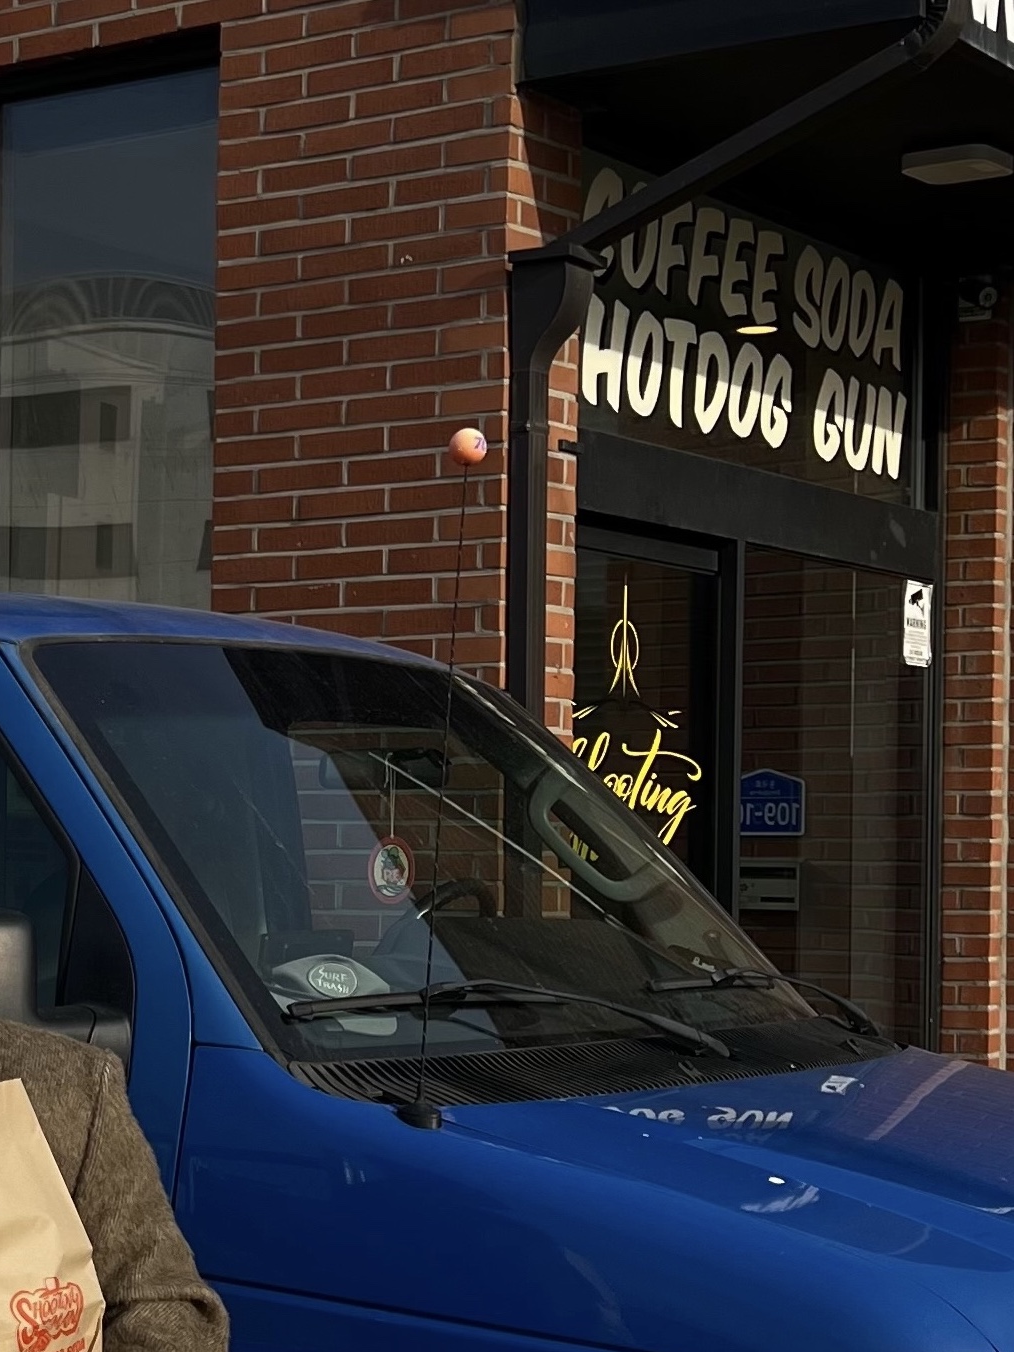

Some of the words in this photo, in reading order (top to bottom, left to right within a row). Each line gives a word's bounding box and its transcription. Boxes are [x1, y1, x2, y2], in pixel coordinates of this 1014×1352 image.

[793, 246, 903, 371] SODA
[581, 294, 792, 449] HOTDOG
[813, 368, 907, 480] GUN
[318, 966, 347, 983] SURF
